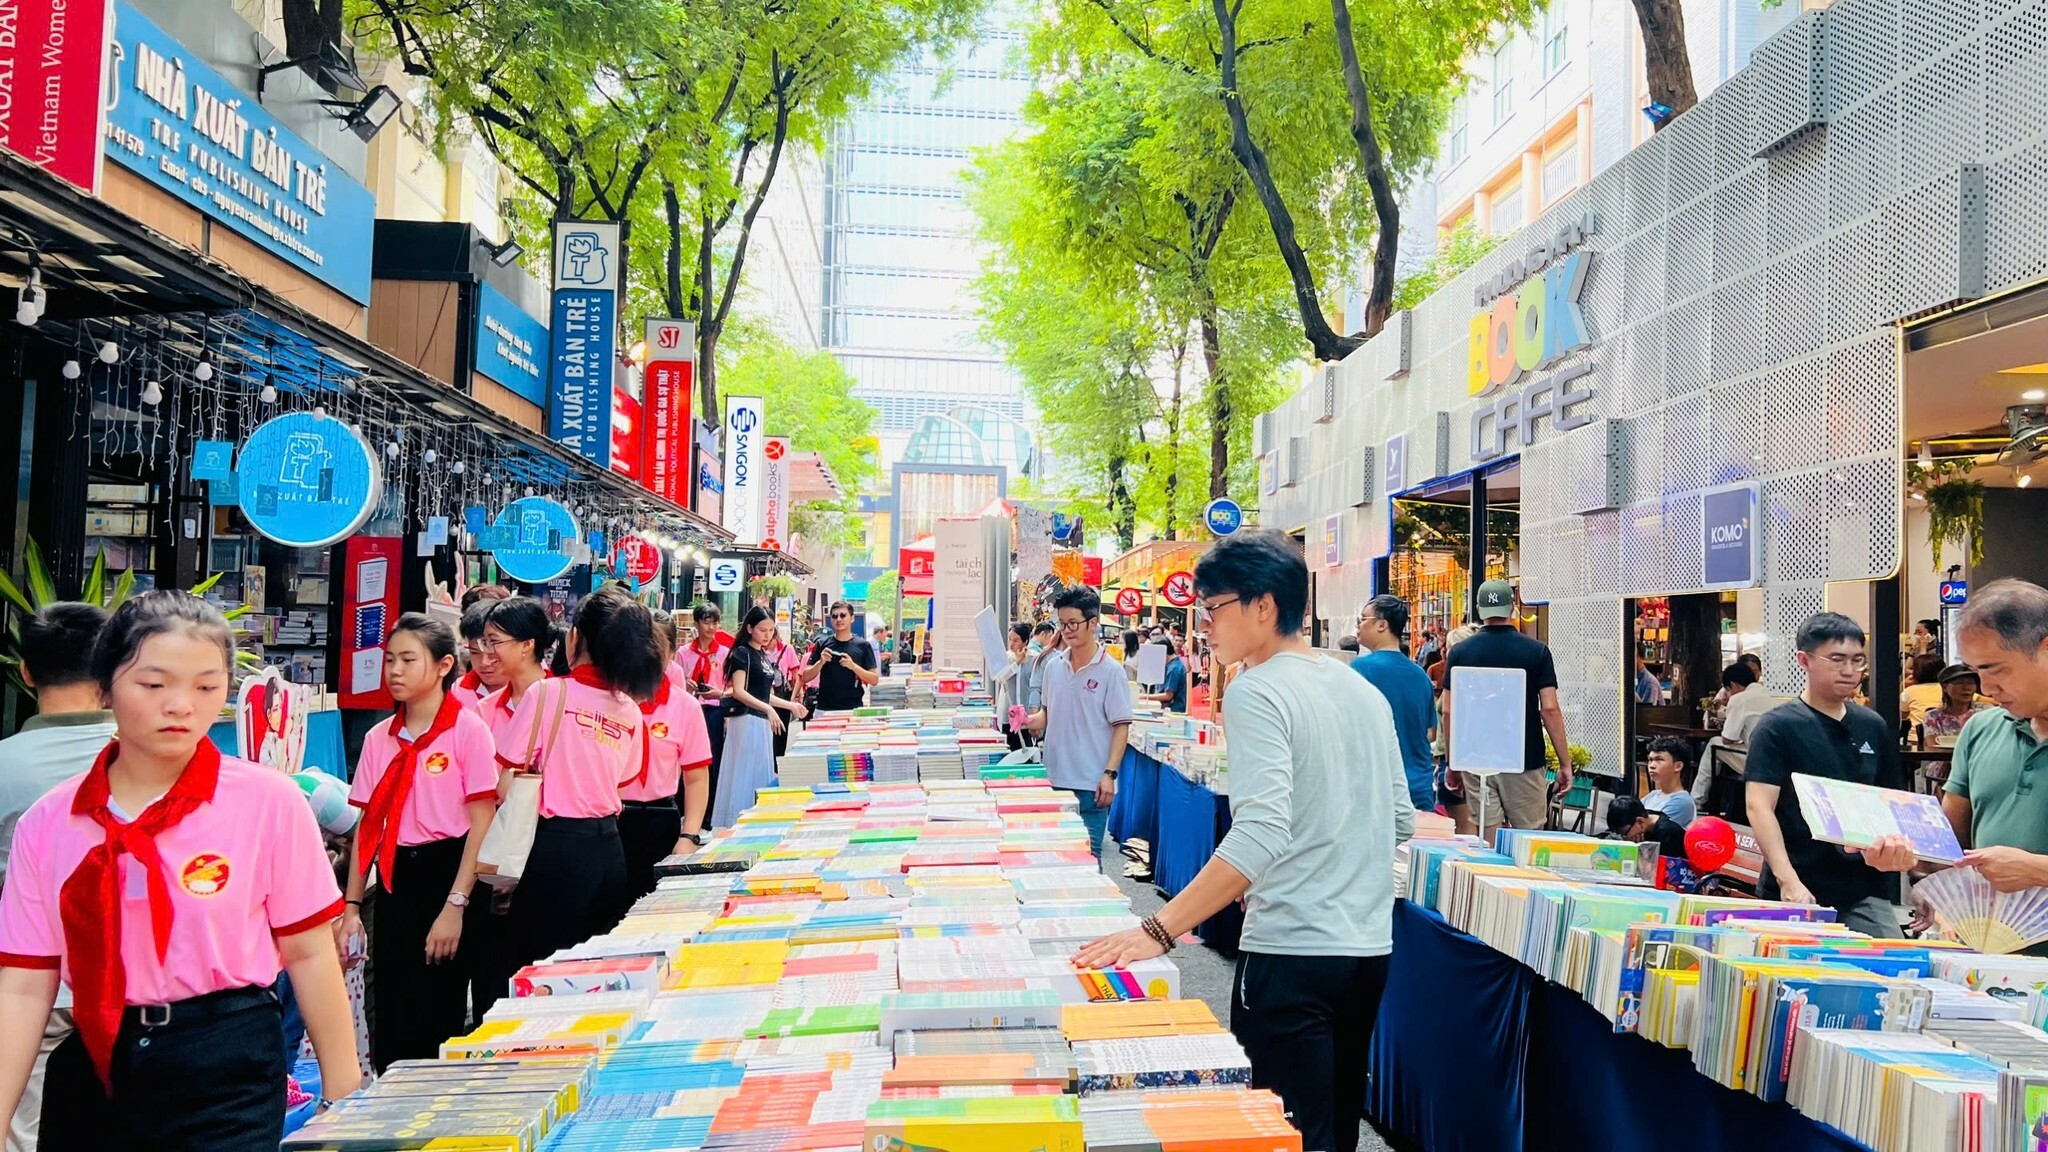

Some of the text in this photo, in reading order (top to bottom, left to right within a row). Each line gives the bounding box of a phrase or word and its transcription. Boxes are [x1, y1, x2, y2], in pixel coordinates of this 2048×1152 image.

[34, 75, 61, 166] Vietnam
[134, 42, 327, 217] NHÀ XUẤT BẢN TRẺ
[151, 118, 309, 235] TRE PUBLISHING HOUSE
[560, 297, 587, 332] TRẺ
[590, 297, 601, 341] HOUSE
[658, 326, 680, 348] ST
[1467, 251, 1594, 398] BOOK
[559, 337, 586, 378] BẢN
[586, 352, 600, 442] PUBLISHING
[673, 370, 681, 393] HOUSE
[556, 383, 585, 431] XUẤT
[671, 394, 680, 437] PUBLISHING
[1470, 362, 1593, 462] CAFE
[735, 434, 748, 487] SAIGON
[626, 541, 643, 560] ST
[1710, 523, 1743, 544] KOMO
